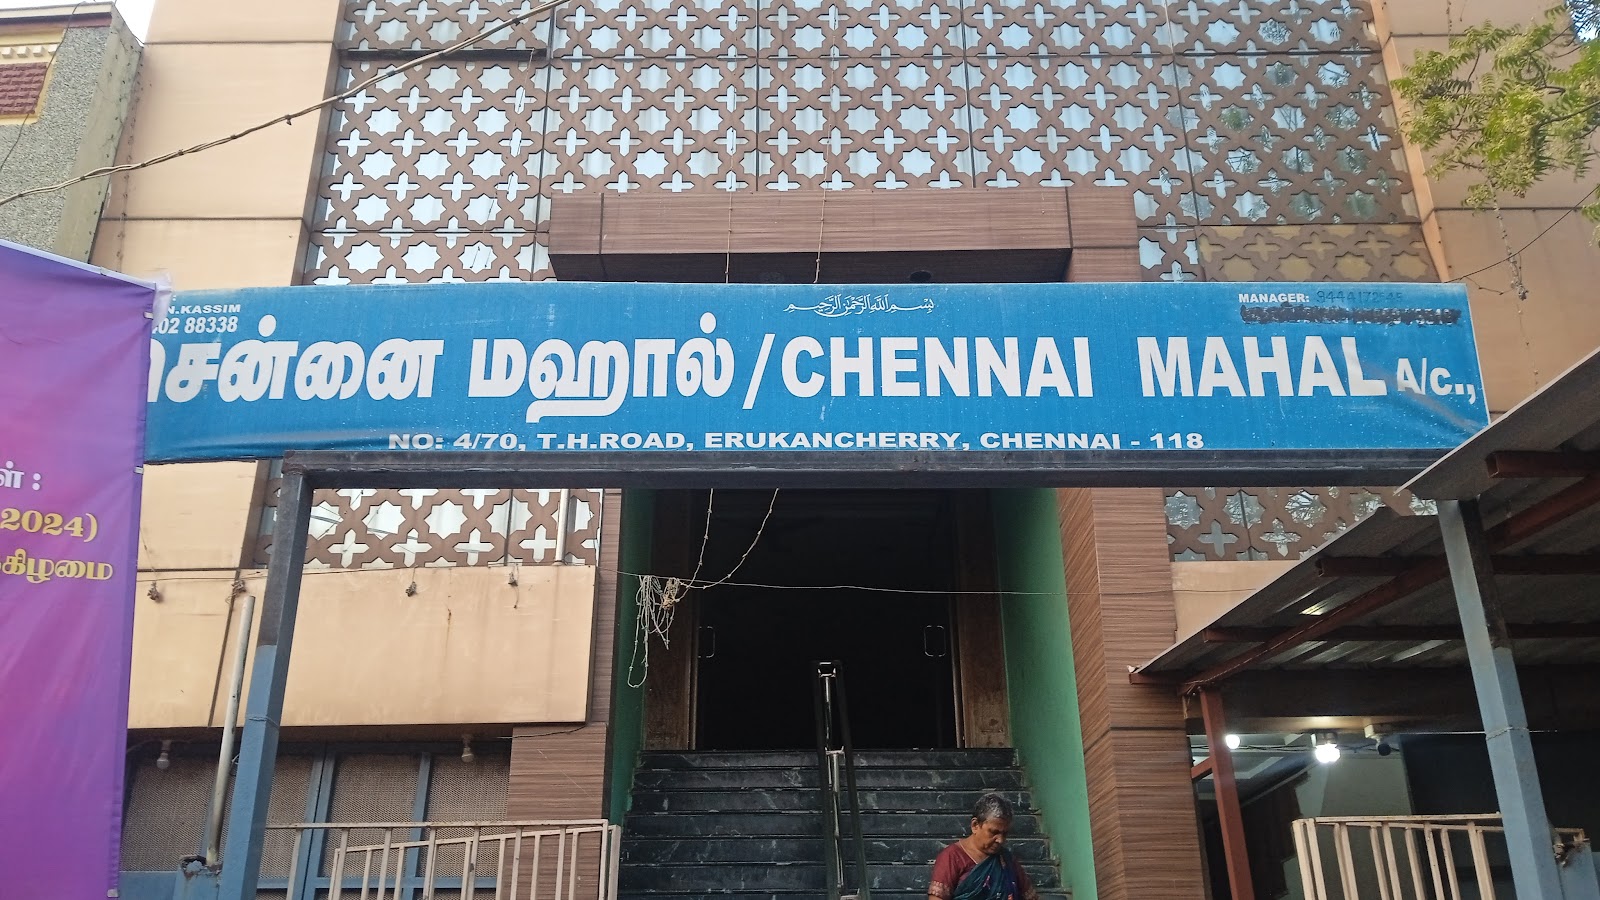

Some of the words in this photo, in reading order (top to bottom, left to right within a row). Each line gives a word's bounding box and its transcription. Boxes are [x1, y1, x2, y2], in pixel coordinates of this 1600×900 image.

[1238, 293, 1310, 303] MANAGER:
[184, 316, 239, 334] 88338
[467, 312, 736, 424] மஹால்
[781, 336, 1094, 398] CHENNAI
[1136, 336, 1388, 397] MAHAL
[388, 433, 443, 450] NO:
[453, 433, 527, 452] 4/70,
[536, 433, 695, 452] T.H.ROAD,
[704, 432, 972, 452] ERUKANCHERRY,
[980, 432, 1120, 450] CHENNAI
[1150, 432, 1205, 450] 118
